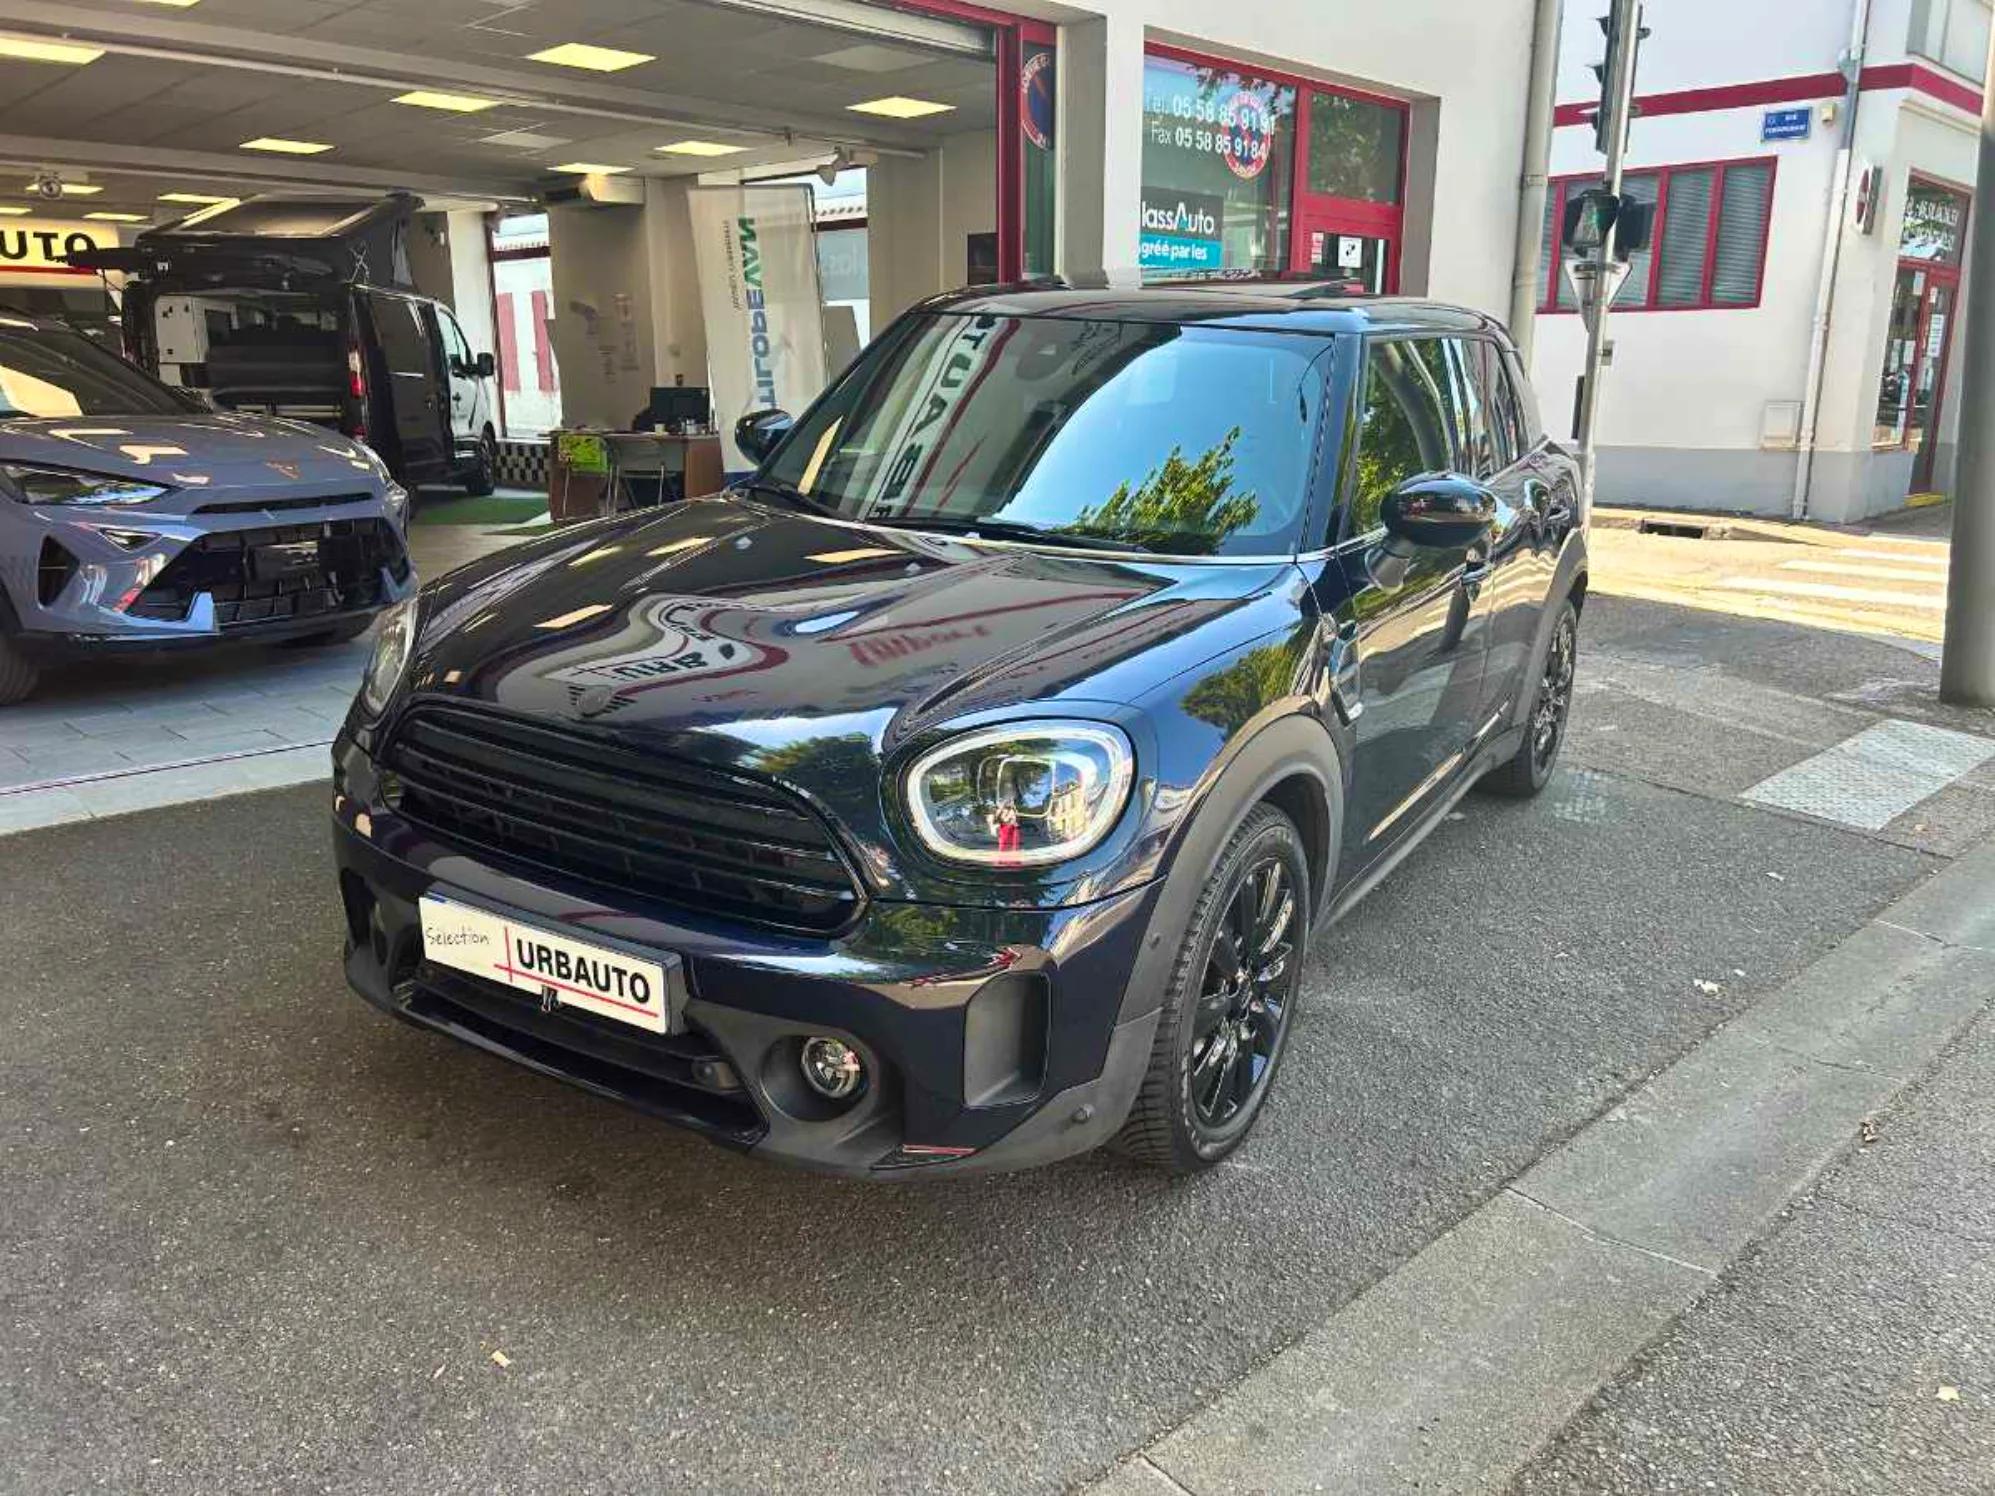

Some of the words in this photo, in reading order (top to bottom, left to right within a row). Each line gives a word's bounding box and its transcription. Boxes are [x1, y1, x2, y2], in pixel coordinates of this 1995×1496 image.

[1173, 95, 1191, 118] 05
[1196, 98, 1215, 122] 58
[1151, 120, 1171, 144] Fax
[1175, 126, 1193, 147] 05
[1196, 130, 1213, 151] 58
[1215, 133, 1231, 154] 85
[426, 926, 490, 945] Selection
[516, 938, 651, 1004] URBAUTO
